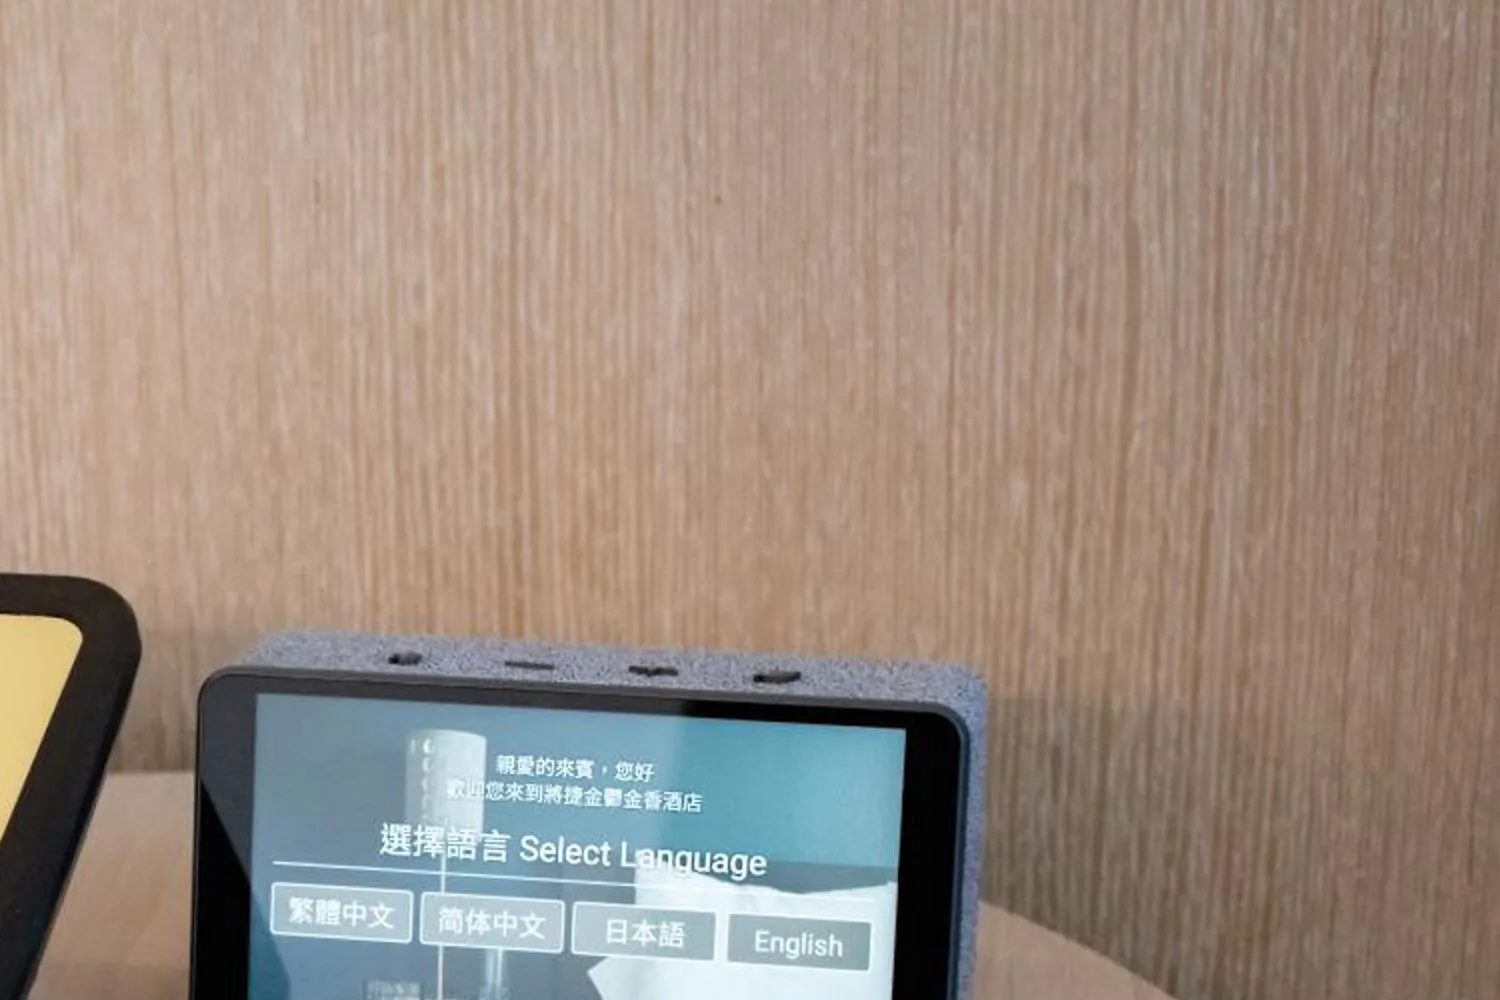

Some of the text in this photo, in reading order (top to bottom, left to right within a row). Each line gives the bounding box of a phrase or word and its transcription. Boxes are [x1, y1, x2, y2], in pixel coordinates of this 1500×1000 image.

[495, 755, 655, 782] 親愛的來賓，您好
[380, 822, 767, 881] 選擇語言 Select Language
[289, 897, 394, 930] 繁體中文
[438, 907, 548, 939] 简体中文
[606, 918, 685, 949] 日本語
[754, 929, 844, 960] English
